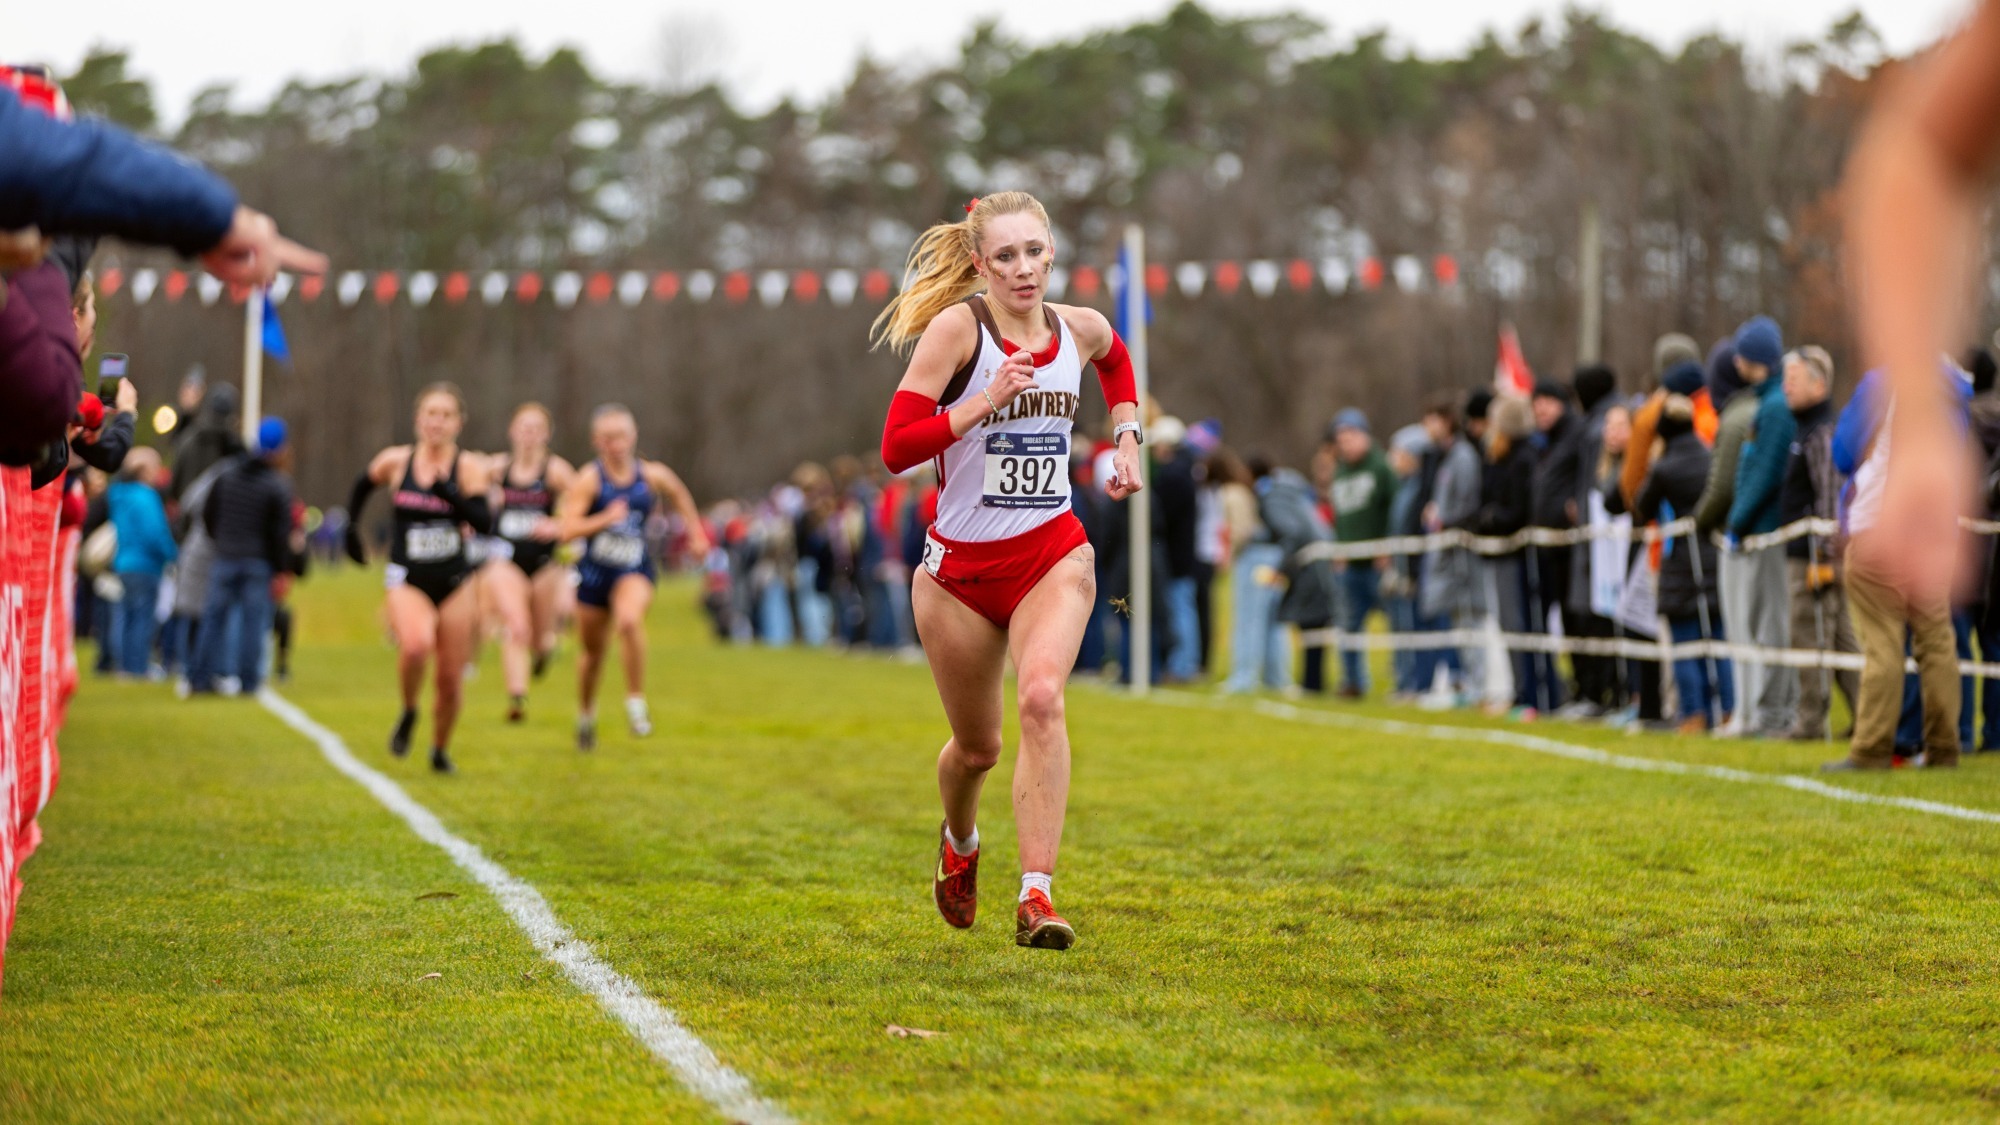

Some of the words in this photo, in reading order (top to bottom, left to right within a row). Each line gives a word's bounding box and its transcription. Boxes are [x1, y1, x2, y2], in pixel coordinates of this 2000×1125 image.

[1022, 436, 1044, 444] MIDEAST
[1044, 436, 1060, 444] REGION
[1000, 457, 1056, 495] 392
